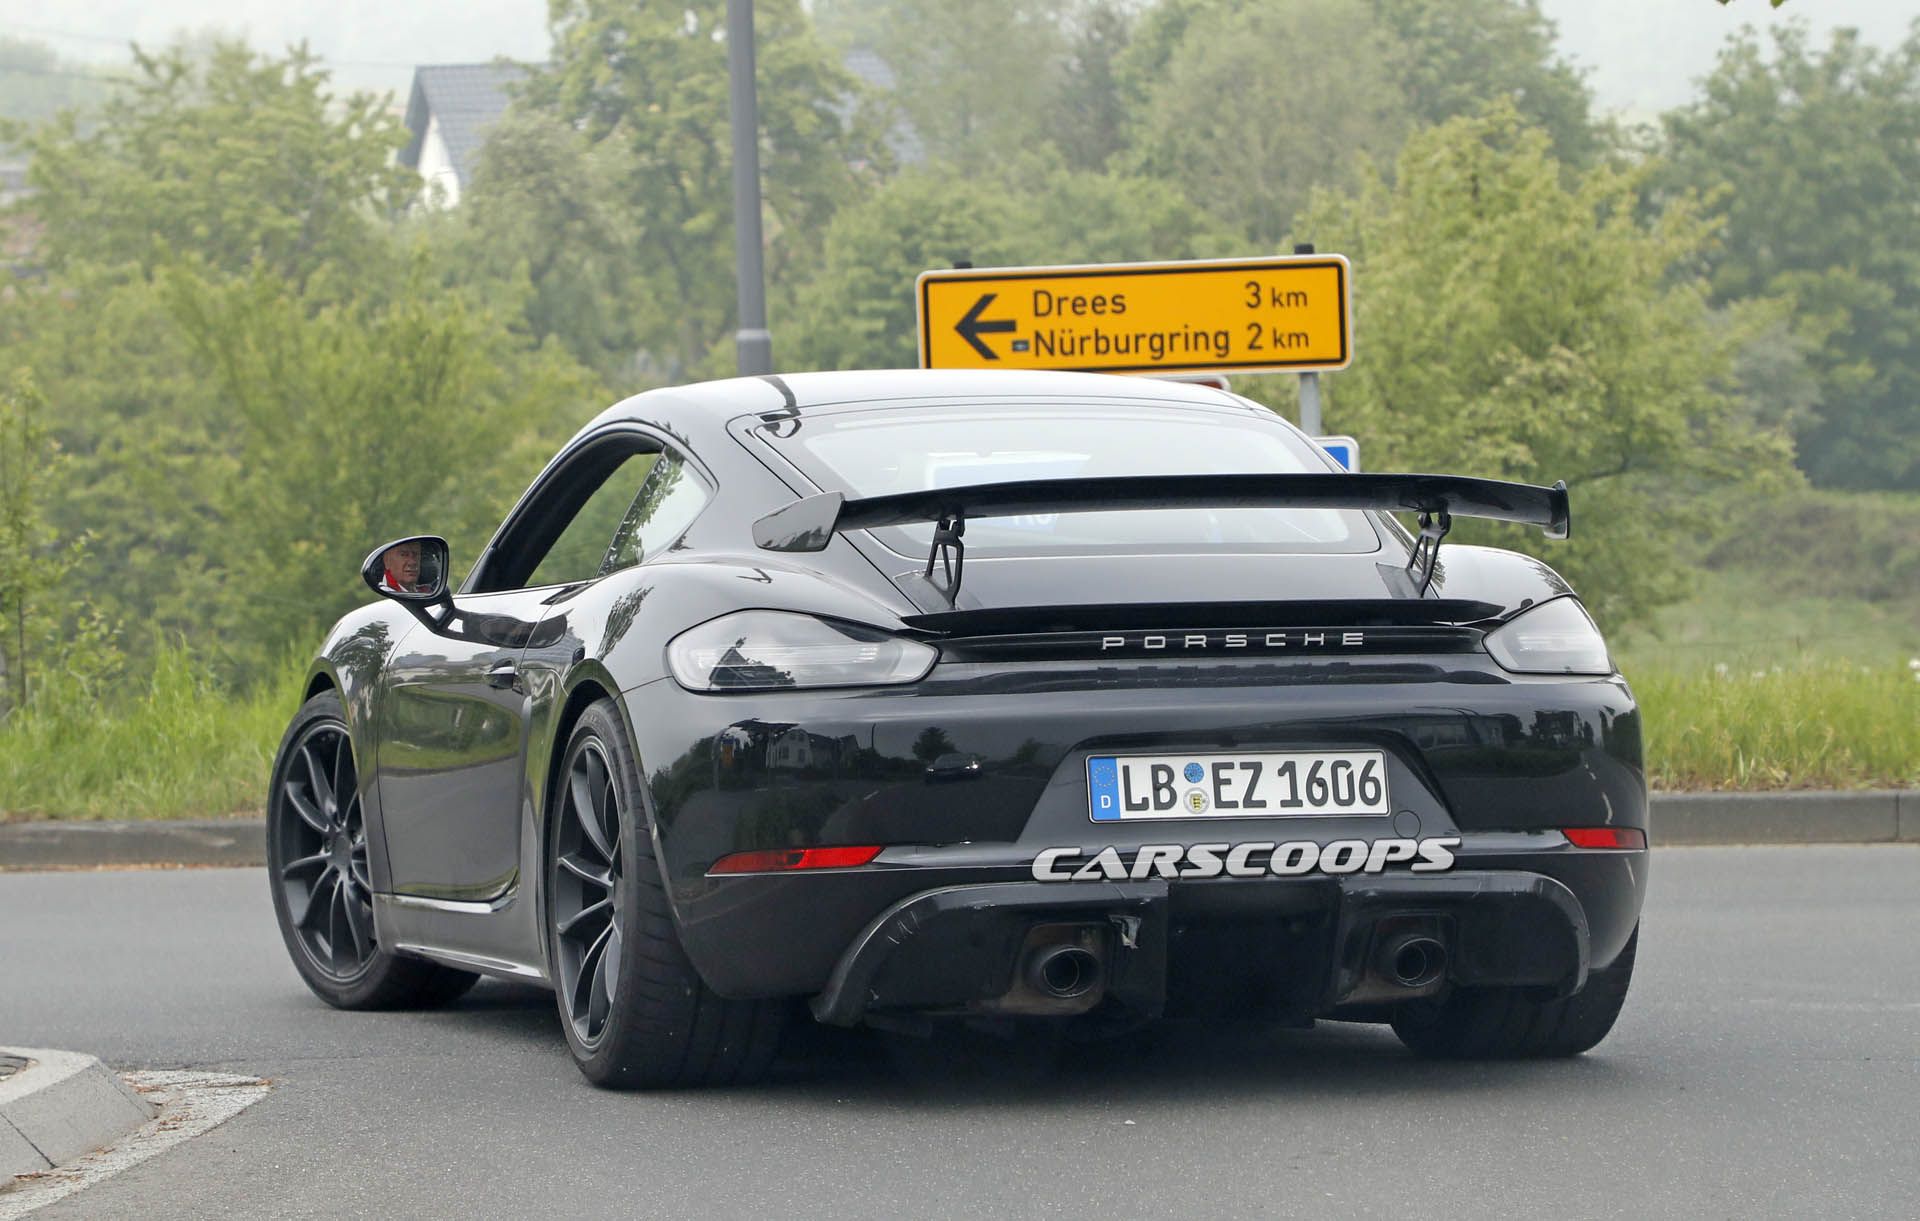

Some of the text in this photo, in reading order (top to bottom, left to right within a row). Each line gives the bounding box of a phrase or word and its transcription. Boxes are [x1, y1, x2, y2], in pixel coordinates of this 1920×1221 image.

[1033, 282, 1308, 317] Drees 3 km
[1034, 323, 1309, 360] Nürburgring 2 km
[1102, 632, 1364, 650] PORSCHE
[1100, 795, 1112, 808] D
[1122, 759, 1382, 811] LB EZ 1606
